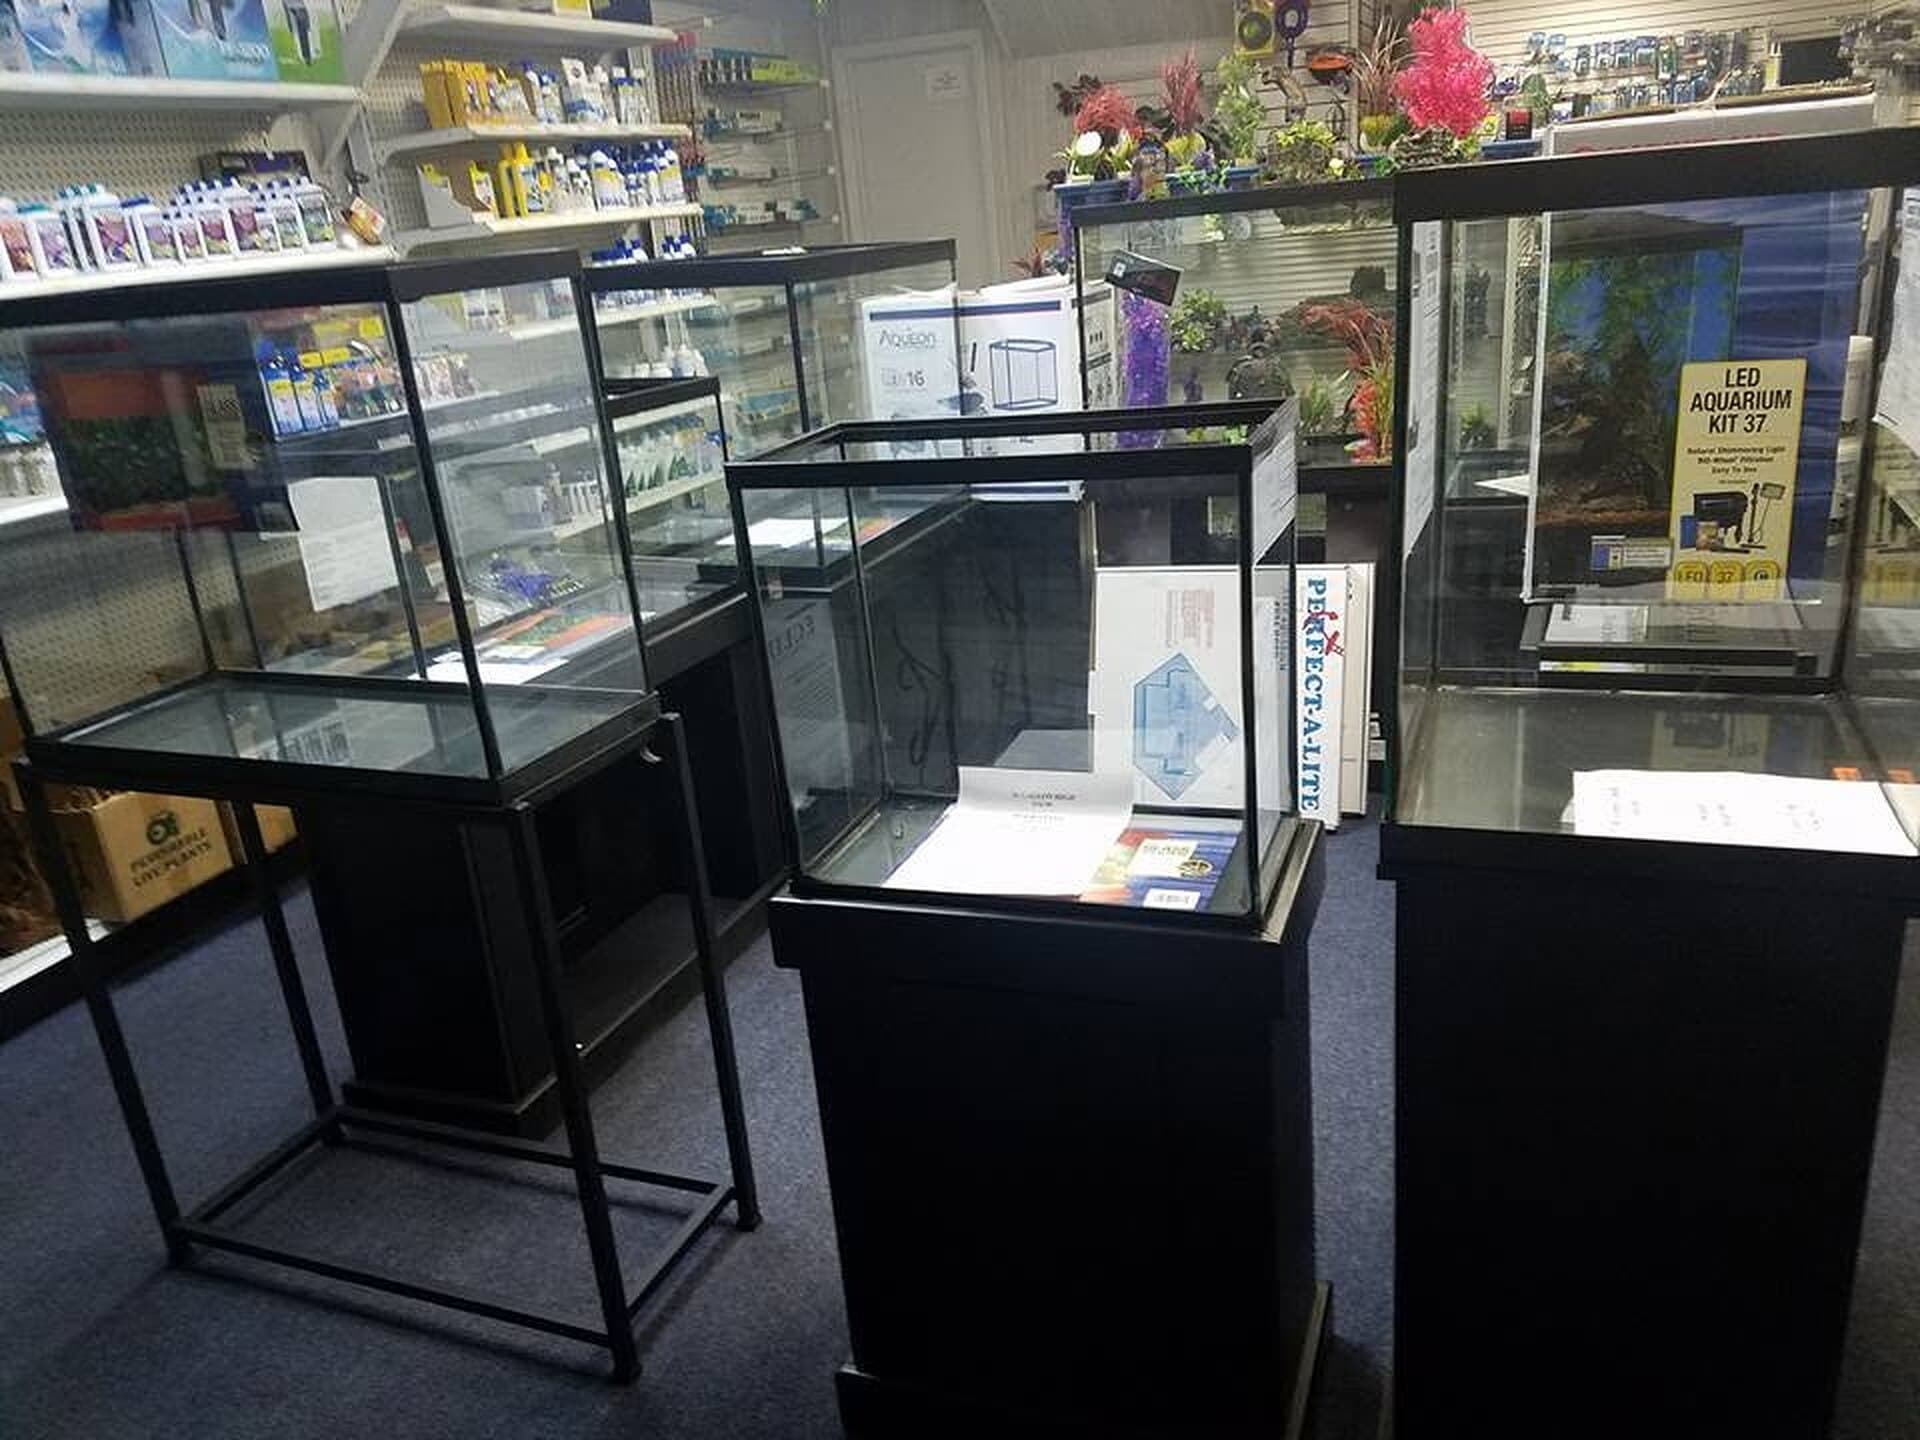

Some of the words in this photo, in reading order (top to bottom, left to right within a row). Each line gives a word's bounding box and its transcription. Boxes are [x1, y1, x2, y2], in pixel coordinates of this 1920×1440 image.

[1725, 367, 1760, 388] LED
[1690, 390, 1792, 412] AQUARIUM
[1709, 414, 1738, 433] KIT
[1743, 414, 1767, 433] 37
[1300, 578, 1327, 812] PERFECT-A-LITE
